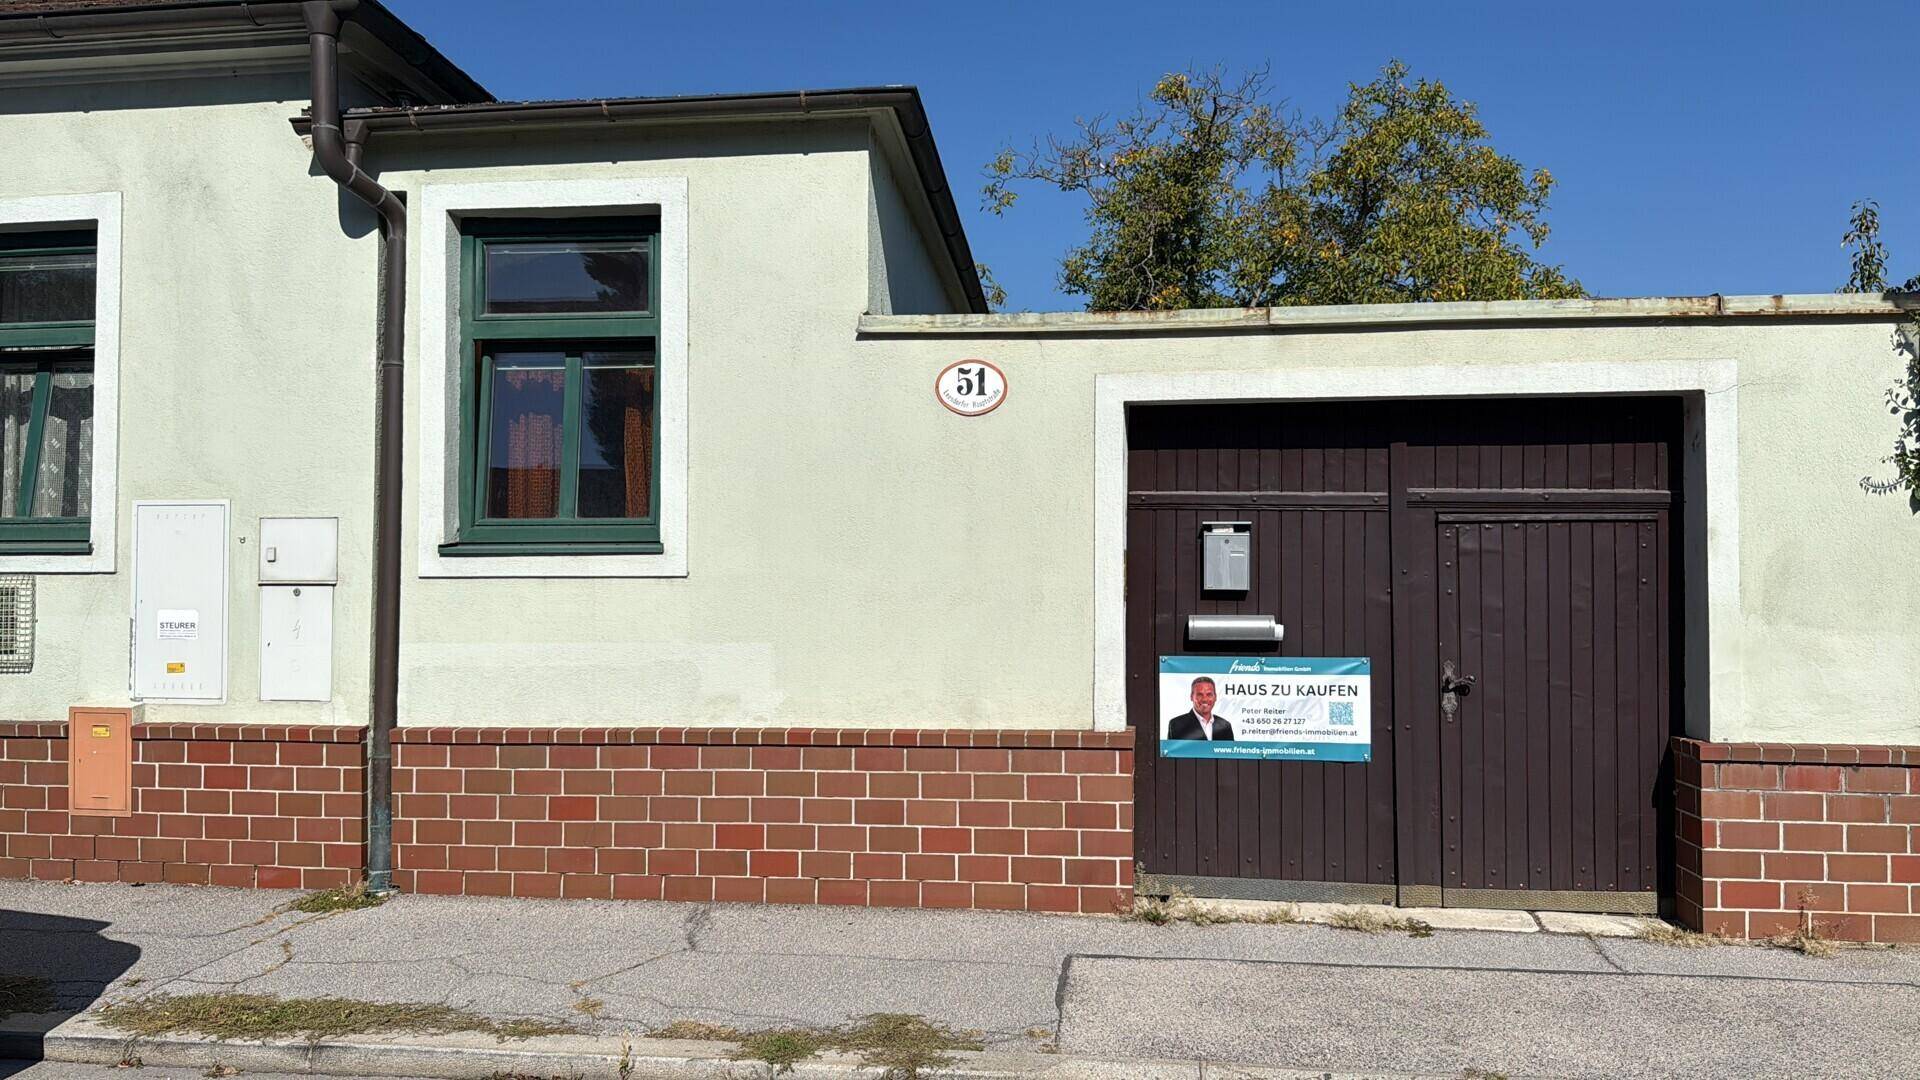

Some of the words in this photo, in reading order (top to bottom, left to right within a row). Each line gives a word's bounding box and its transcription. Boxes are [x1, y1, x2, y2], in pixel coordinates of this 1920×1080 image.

[957, 367, 987, 396] 51
[1229, 659, 1261, 674] friends
[1225, 683, 1268, 696] HAUS
[1271, 684, 1291, 696] ZU
[1296, 684, 1359, 697] KAUFEN
[1241, 707, 1261, 715] Peter
[1263, 707, 1287, 715] Reiter
[1241, 728, 1358, 737] p.reiter@friends-immobilien.at
[1213, 746, 1316, 756] www.friends-immobilien.at
